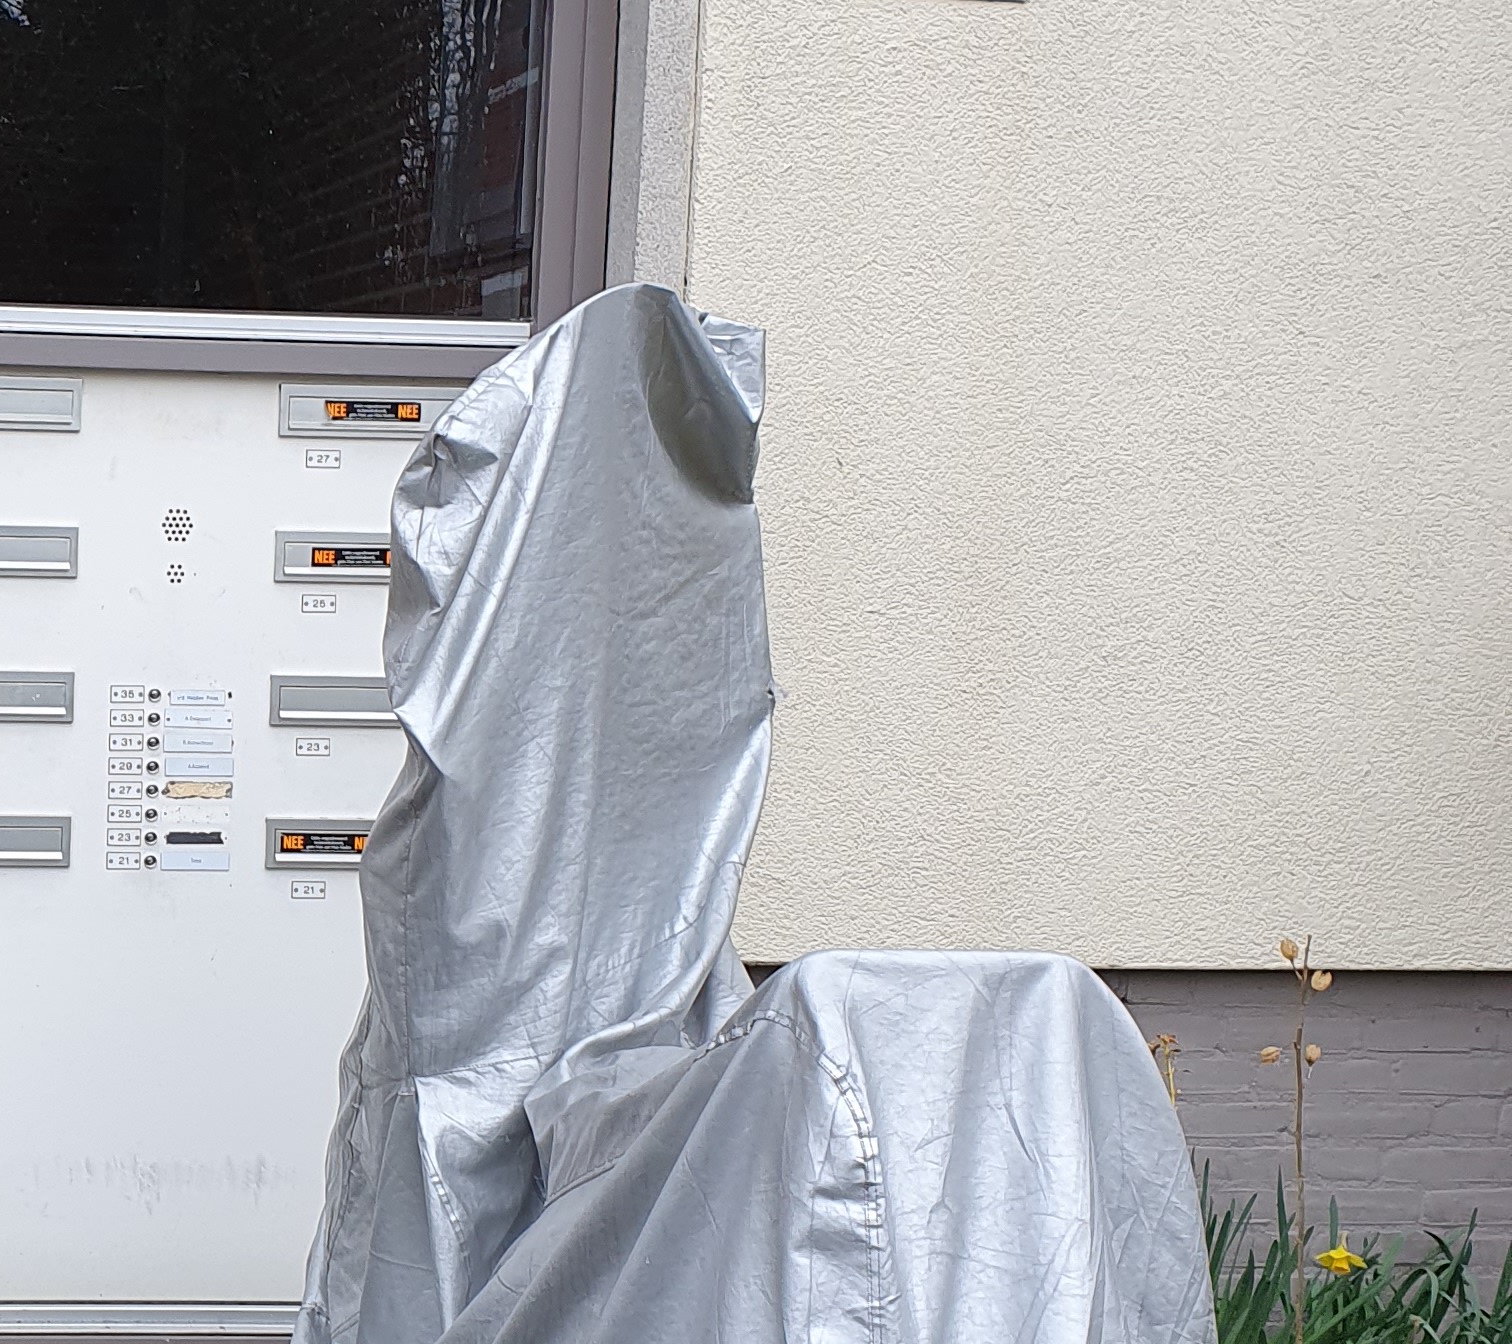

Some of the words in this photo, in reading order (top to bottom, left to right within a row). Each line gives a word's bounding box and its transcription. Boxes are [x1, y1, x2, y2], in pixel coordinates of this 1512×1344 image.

[397, 403, 419, 419] NEE
[316, 454, 331, 464] 27
[314, 549, 336, 564] NEE
[120, 689, 135, 699] 35
[120, 713, 135, 723] 33
[120, 737, 133, 747] 31
[306, 742, 320, 752] 23
[118, 785, 133, 795] 27
[117, 809, 132, 819] 25
[117, 832, 132, 842] 23
[282, 835, 304, 849] NEE
[118, 855, 130, 865] 21
[303, 885, 315, 895] 21
